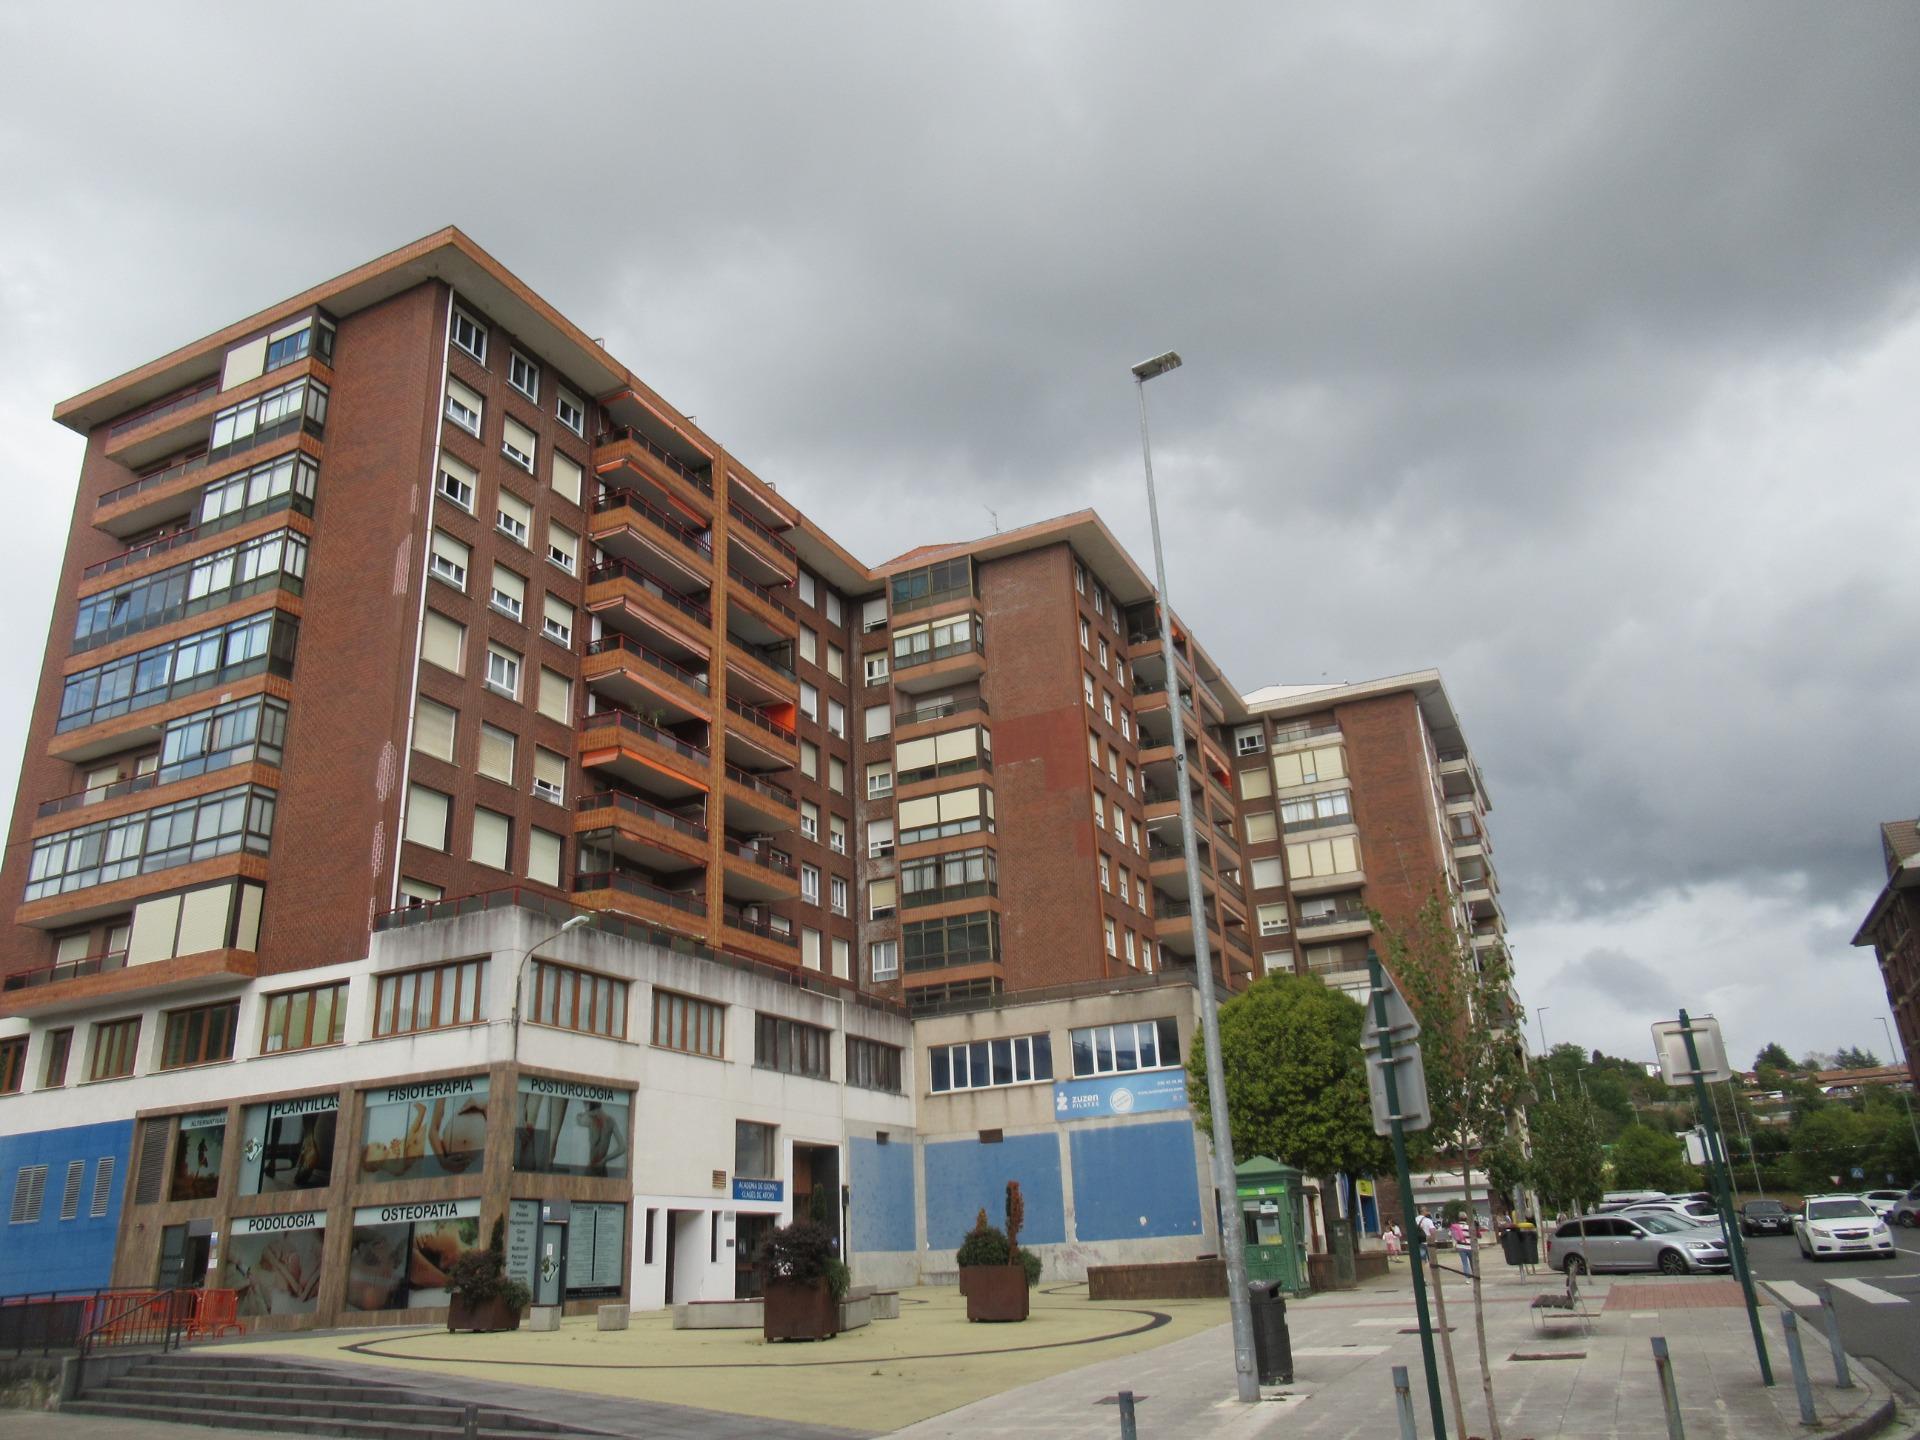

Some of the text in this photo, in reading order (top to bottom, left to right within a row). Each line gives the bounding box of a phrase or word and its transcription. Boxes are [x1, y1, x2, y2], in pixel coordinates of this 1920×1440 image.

[387, 1079, 473, 1102] FISIOTERAPIA
[531, 1079, 614, 1101] POSTUROLOGIA
[1072, 1094, 1099, 1103] zuzen
[274, 1096, 340, 1115] PLANTILLAS
[381, 1202, 458, 1221] OSTEOPATIA
[248, 1213, 316, 1232] PODOLOGIA
